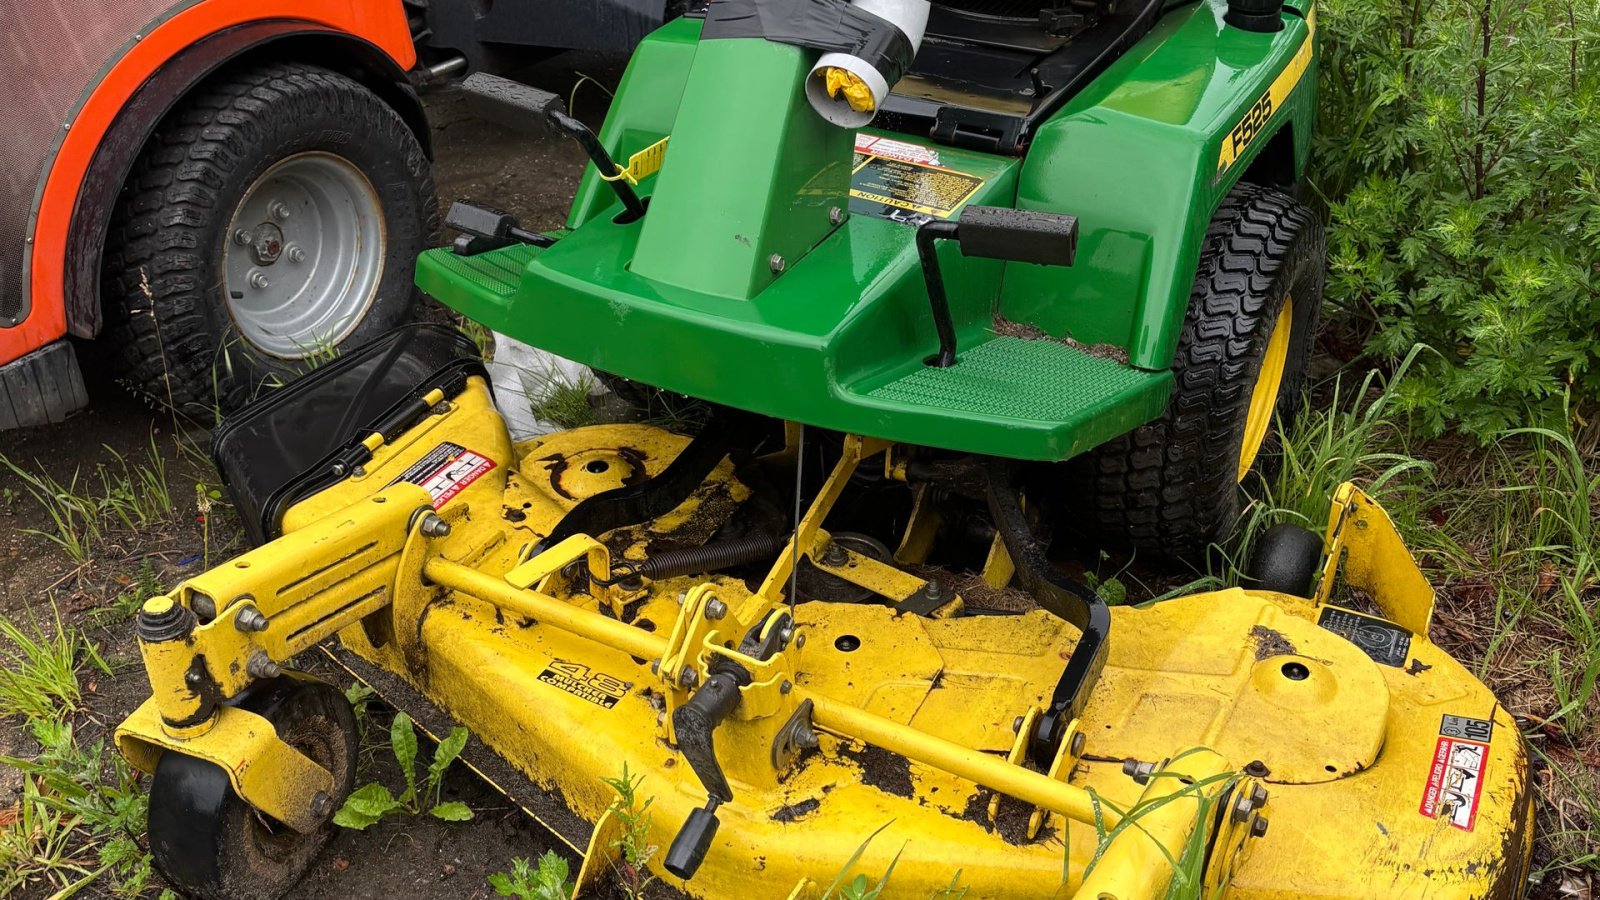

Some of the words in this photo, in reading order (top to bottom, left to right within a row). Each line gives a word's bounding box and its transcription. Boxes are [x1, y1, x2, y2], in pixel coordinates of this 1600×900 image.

[1232, 90, 1272, 159] F525
[857, 191, 909, 208] CAUTION
[459, 467, 487, 486] DANGER
[548, 660, 630, 698] 48
[554, 674, 607, 700] MULCHER
[540, 675, 614, 709] COMPATIBLE
[1464, 720, 1490, 739] 105
[1425, 786, 1438, 811] DANGER
